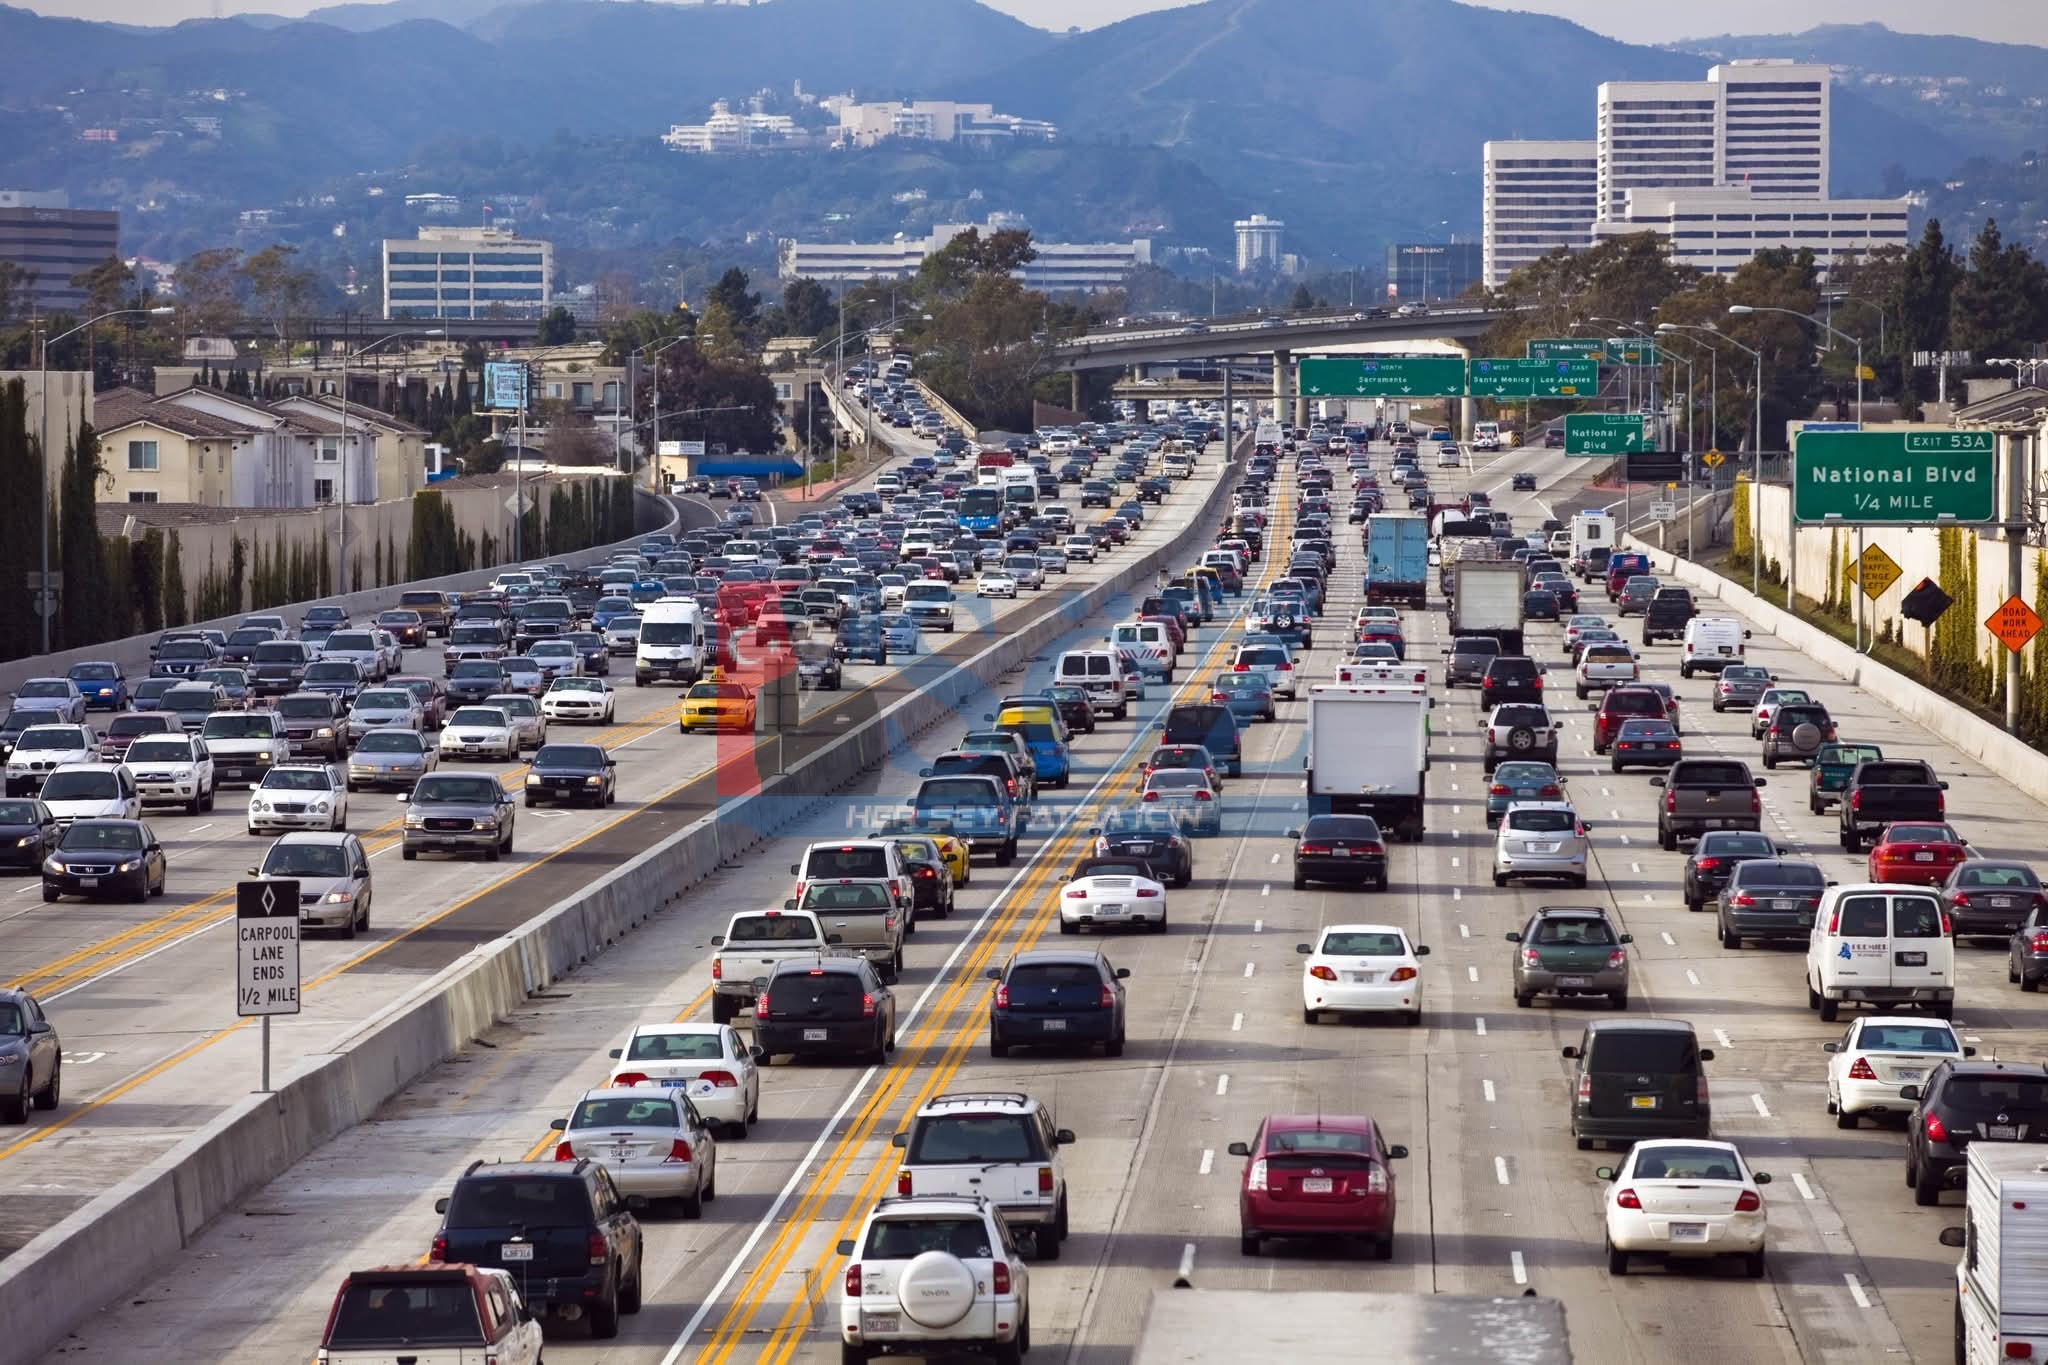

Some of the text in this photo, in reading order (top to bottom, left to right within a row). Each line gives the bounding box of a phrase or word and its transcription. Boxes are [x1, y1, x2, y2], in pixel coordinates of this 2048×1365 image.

[1558, 376, 1591, 384] Angeles
[1572, 429, 1617, 437] National
[1583, 441, 1607, 449] Blvd
[1913, 435, 1985, 448] EXIT 53A
[1812, 466, 1977, 483] National Blvd
[1889, 496, 1934, 508] MILE
[2002, 608, 2027, 616] ROAD
[2002, 619, 2027, 627] WORK
[2001, 630, 2030, 638] AHEAD
[241, 926, 296, 942] CARPOOL
[253, 946, 285, 961] LANE
[253, 966, 285, 980] ENDS
[242, 987, 297, 1005] 1/2 MILE
